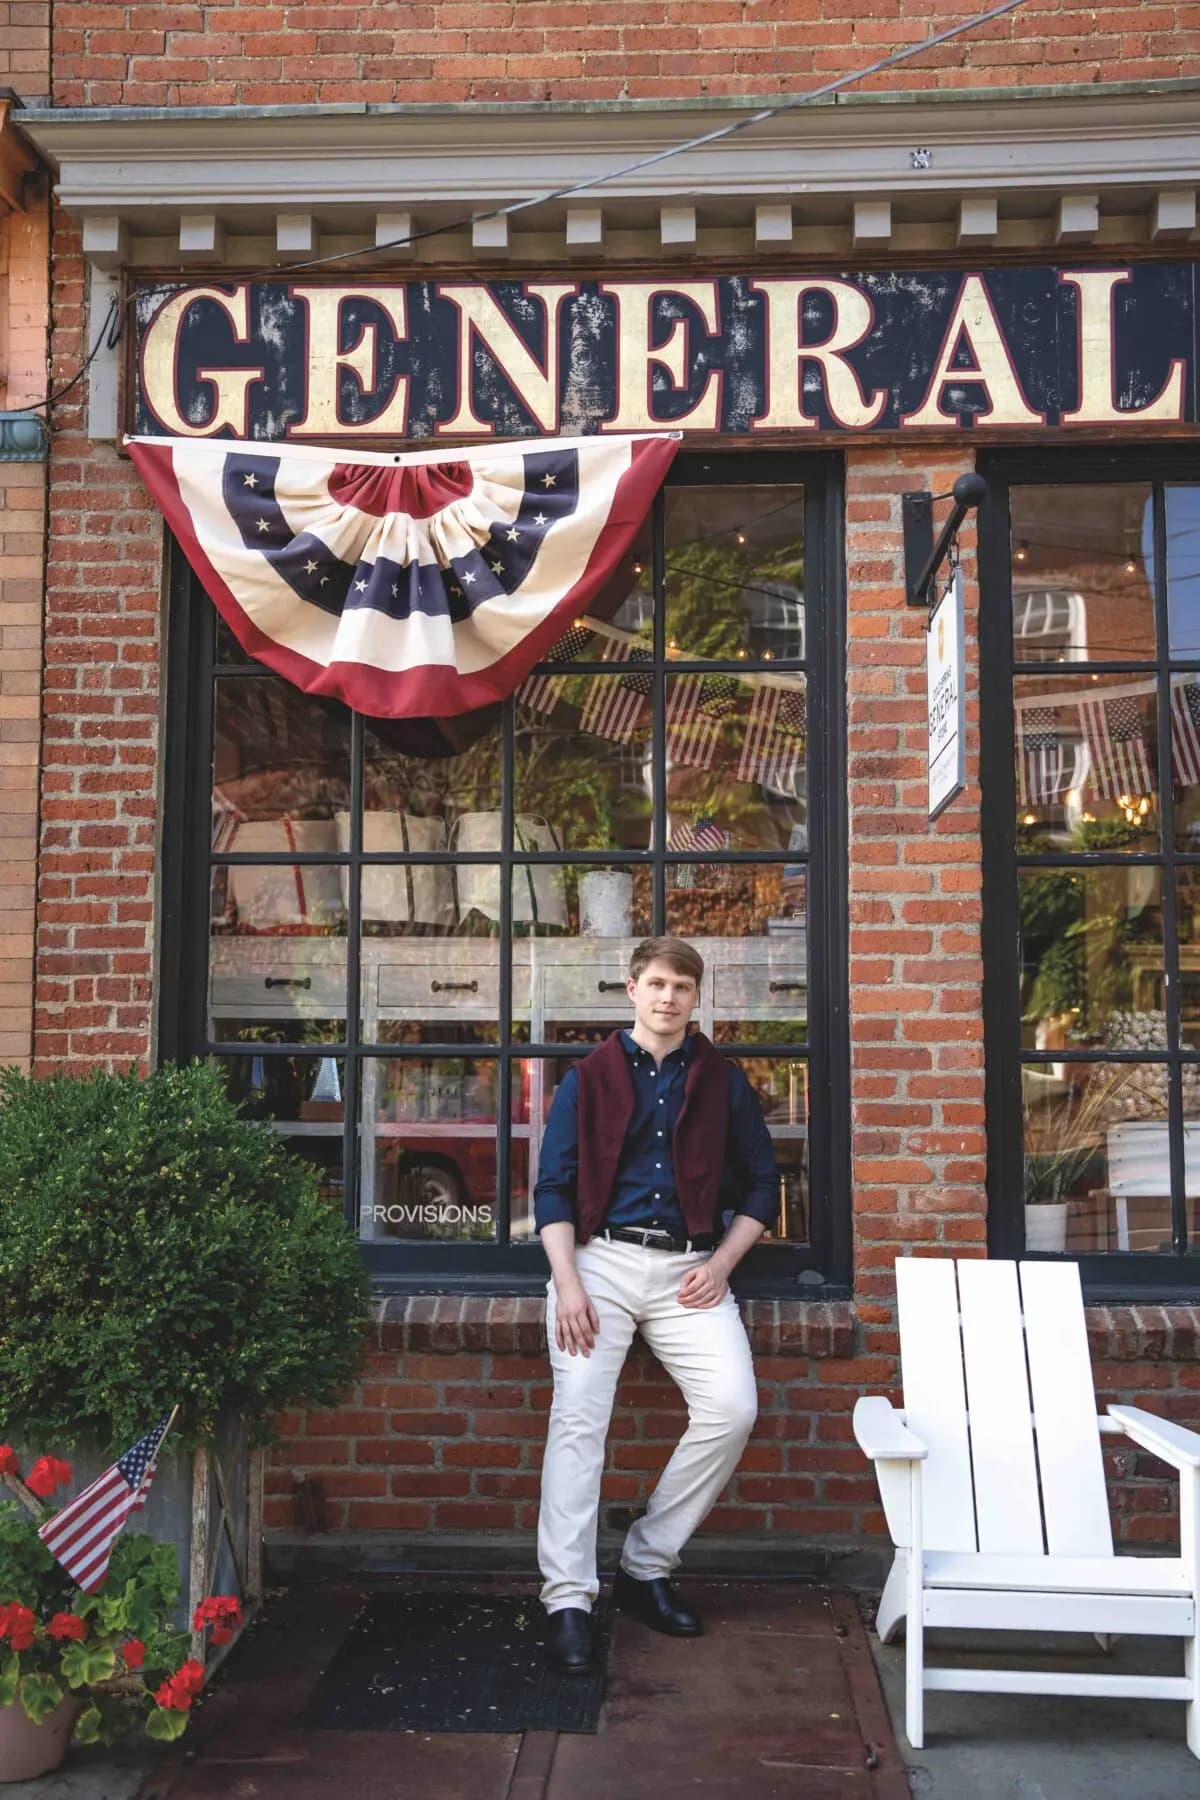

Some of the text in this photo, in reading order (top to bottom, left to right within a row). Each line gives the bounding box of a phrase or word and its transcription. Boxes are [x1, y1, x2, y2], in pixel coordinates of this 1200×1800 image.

[141, 271, 1187, 438] GENERAL
[929, 682, 957, 736] GENERAL
[360, 1204, 492, 1223] PROVISIONS
